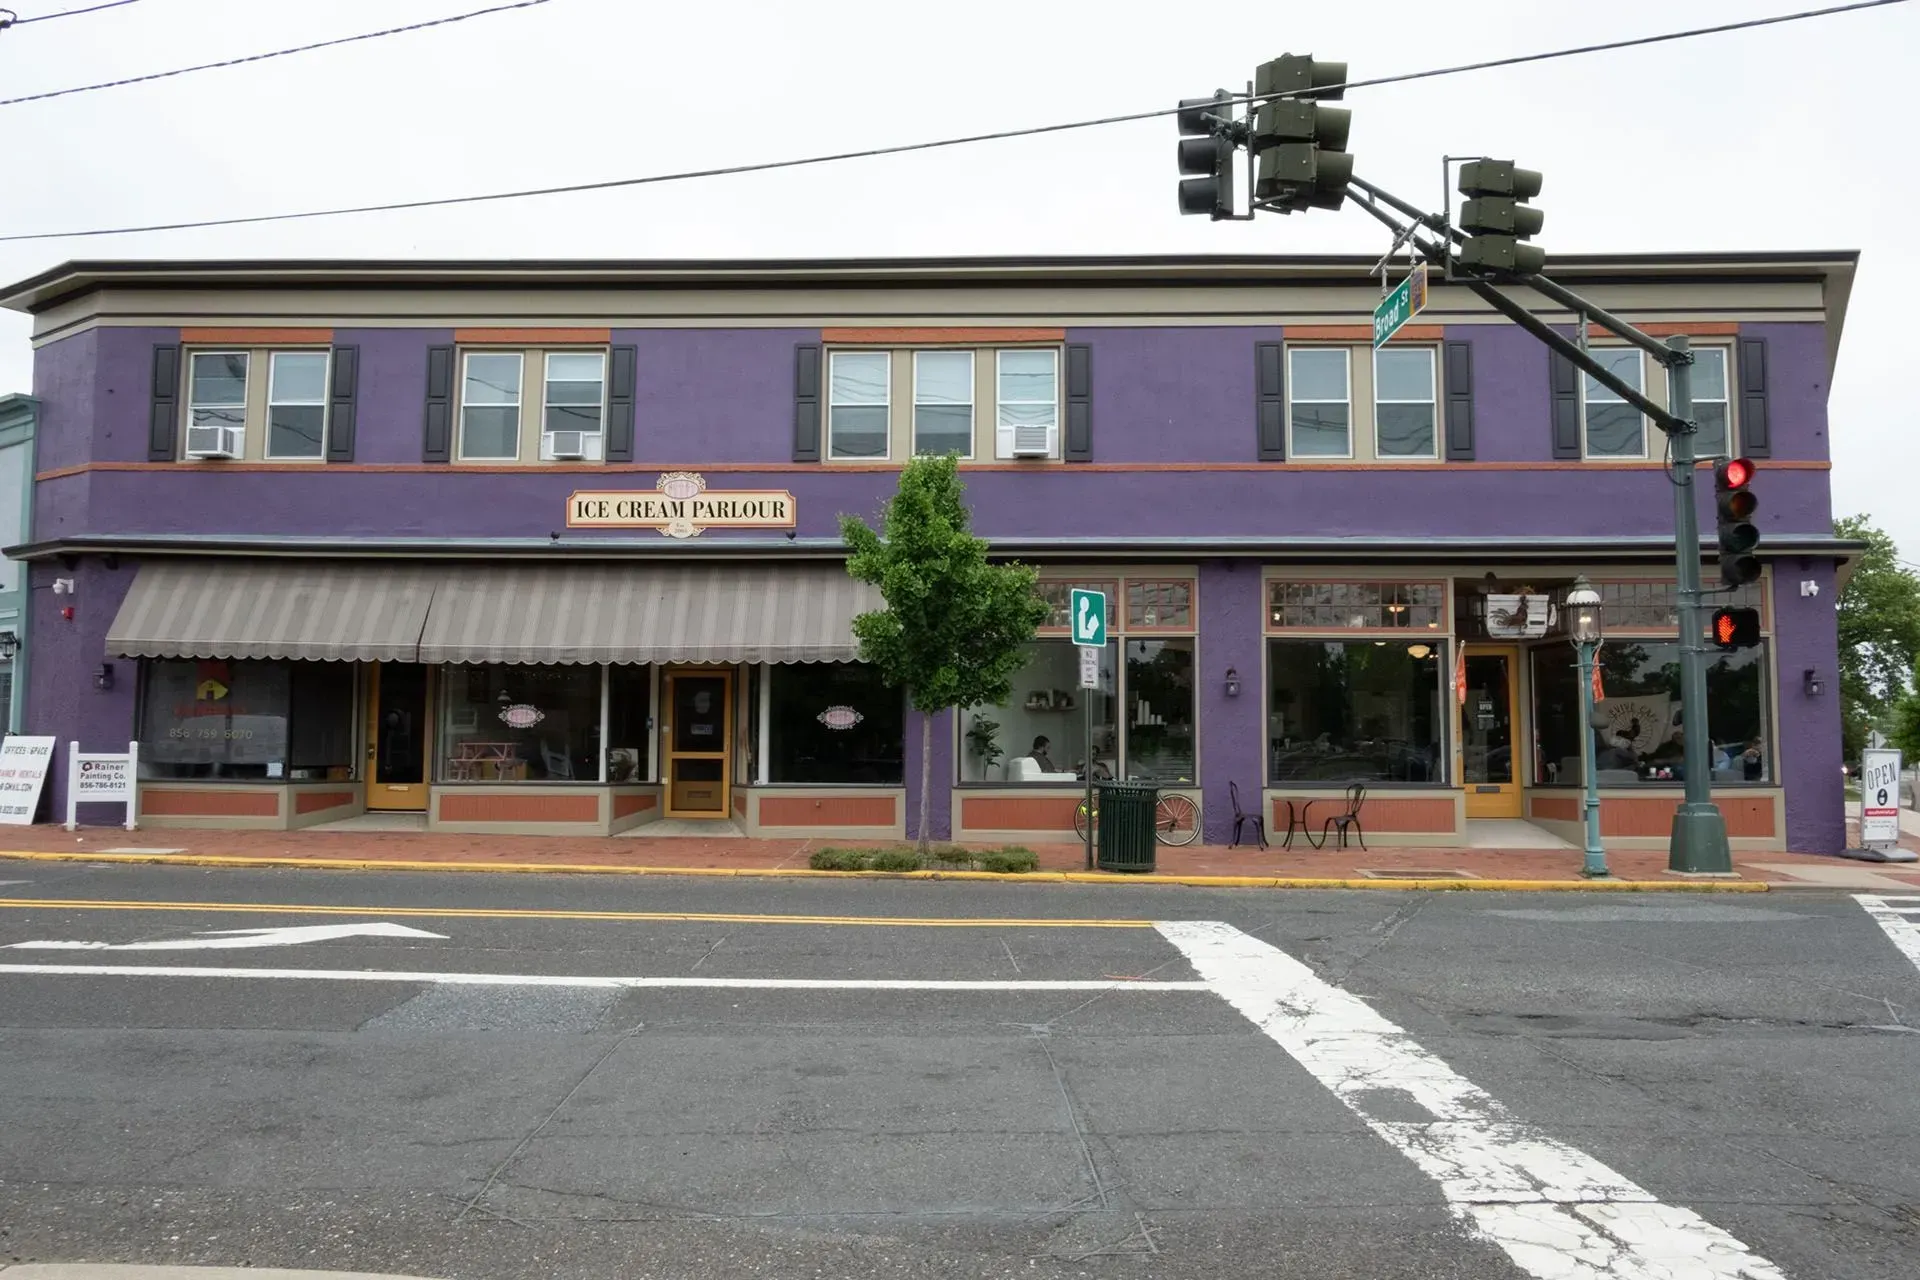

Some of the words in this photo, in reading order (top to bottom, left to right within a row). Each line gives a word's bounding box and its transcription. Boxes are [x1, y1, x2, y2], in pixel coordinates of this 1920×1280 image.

[1376, 298, 1398, 340] Broad
[1401, 288, 1409, 307] St
[577, 500, 609, 518] ICE
[616, 500, 685, 518] CREAM
[693, 500, 785, 518] PARLOUR
[169, 728, 190, 738] 856
[198, 729, 217, 738] 759
[224, 730, 253, 740] 6070
[94, 763, 124, 771] Rainer
[80, 772, 112, 781] Painting
[114, 772, 126, 780] Co.
[1867, 762, 1896, 790] OPEN
[80, 781, 126, 789] 856-786-8121
